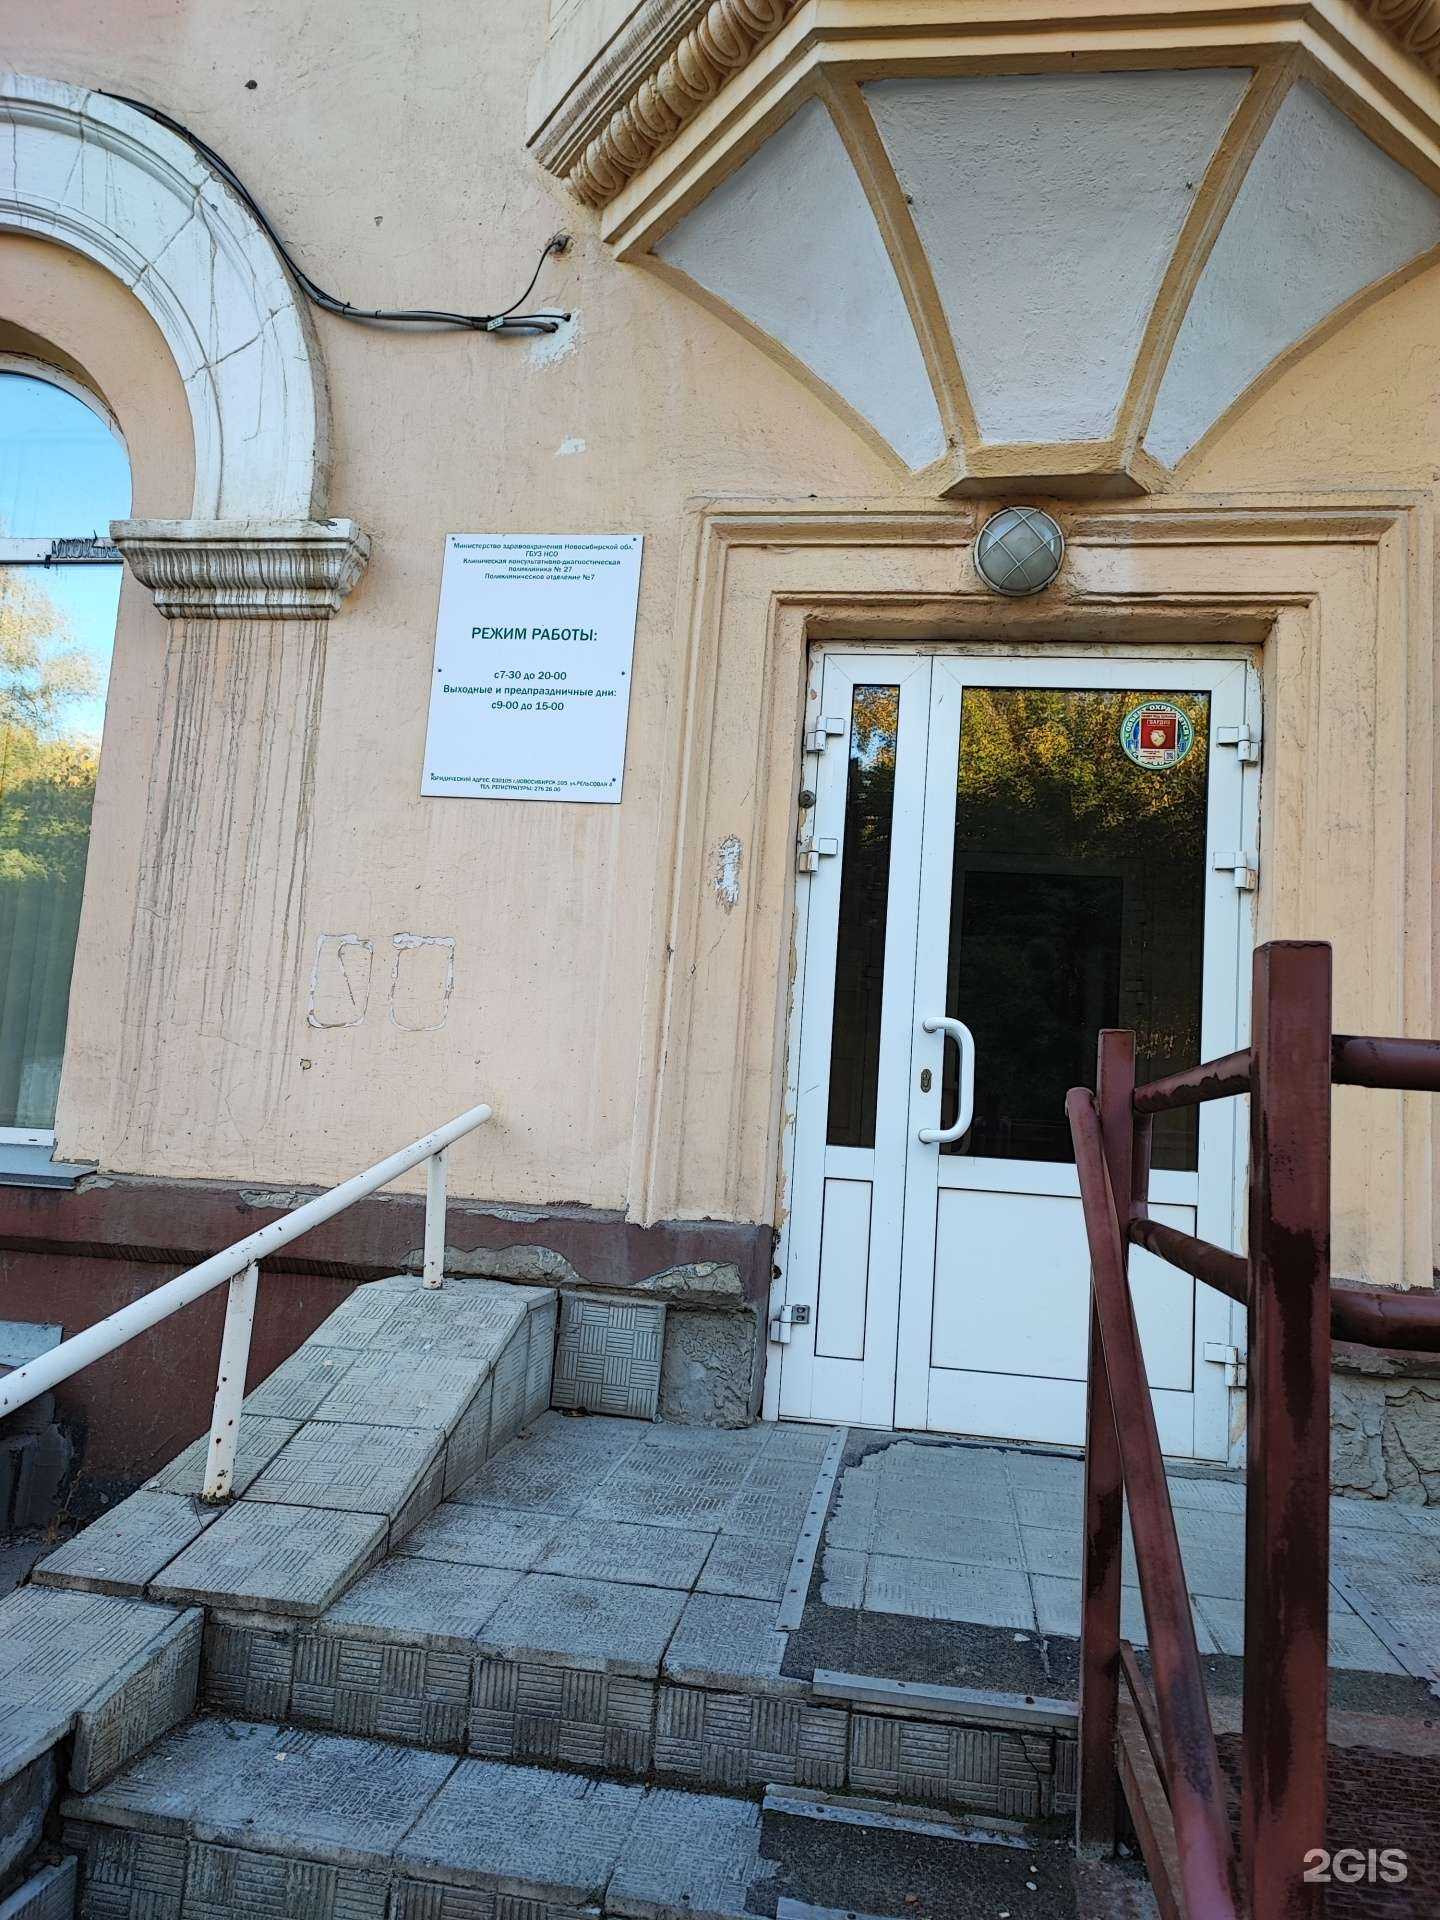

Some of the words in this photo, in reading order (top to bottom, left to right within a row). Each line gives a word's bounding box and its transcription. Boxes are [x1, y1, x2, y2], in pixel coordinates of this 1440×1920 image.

[453, 542, 501, 550] Министерство
[502, 543, 562, 551] здравоохранения
[564, 543, 618, 551] Новосибирской
[463, 557, 507, 565] Клиническая
[508, 558, 621, 566] консультативно-диагностическая
[471, 627, 527, 640] РЕЖИМ
[531, 628, 598, 641] РАБОТЫ:
[493, 670, 522, 680] с7-30
[523, 672, 536, 681] до
[537, 671, 567, 681] 20-00
[443, 684, 493, 695] Выходные
[495, 686, 502, 694] и
[504, 687, 594, 697] предпраздничные
[595, 689, 617, 698] дни:
[491, 700, 519, 710] с9-00
[520, 703, 533, 711] до
[535, 701, 565, 711] 15-00
